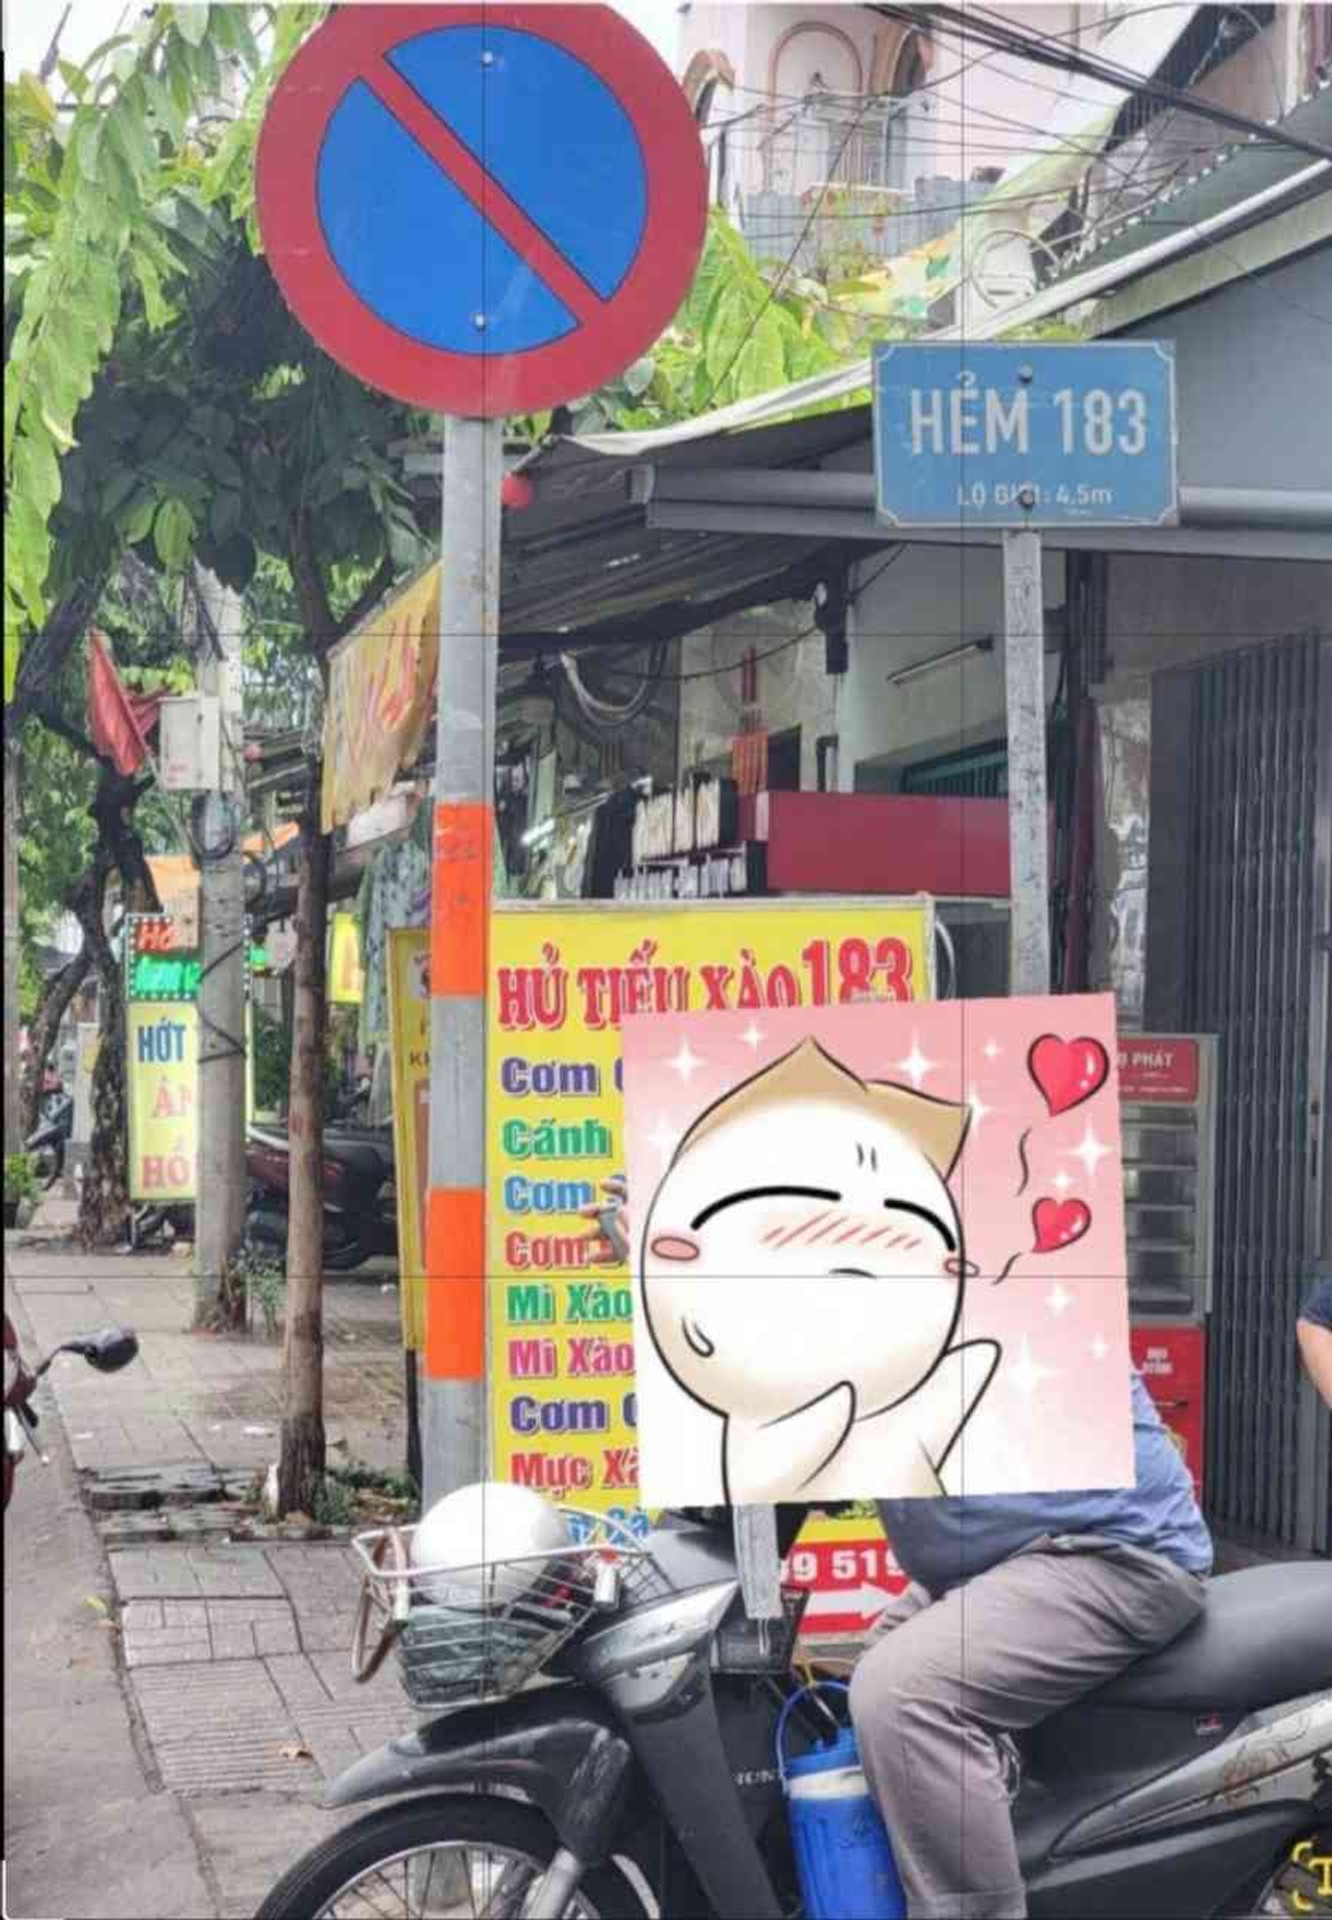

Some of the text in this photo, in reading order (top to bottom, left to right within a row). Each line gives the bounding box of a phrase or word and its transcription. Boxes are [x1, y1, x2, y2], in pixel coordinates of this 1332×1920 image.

[911, 370, 1147, 456] HẺM 183
[497, 940, 569, 1032] HỦ
[699, 948, 802, 1009] XÀO
[802, 936, 913, 1008] 183
[501, 1055, 601, 1098] Cơm
[504, 1175, 596, 1214] Cơm
[510, 1395, 610, 1434] Cơm
